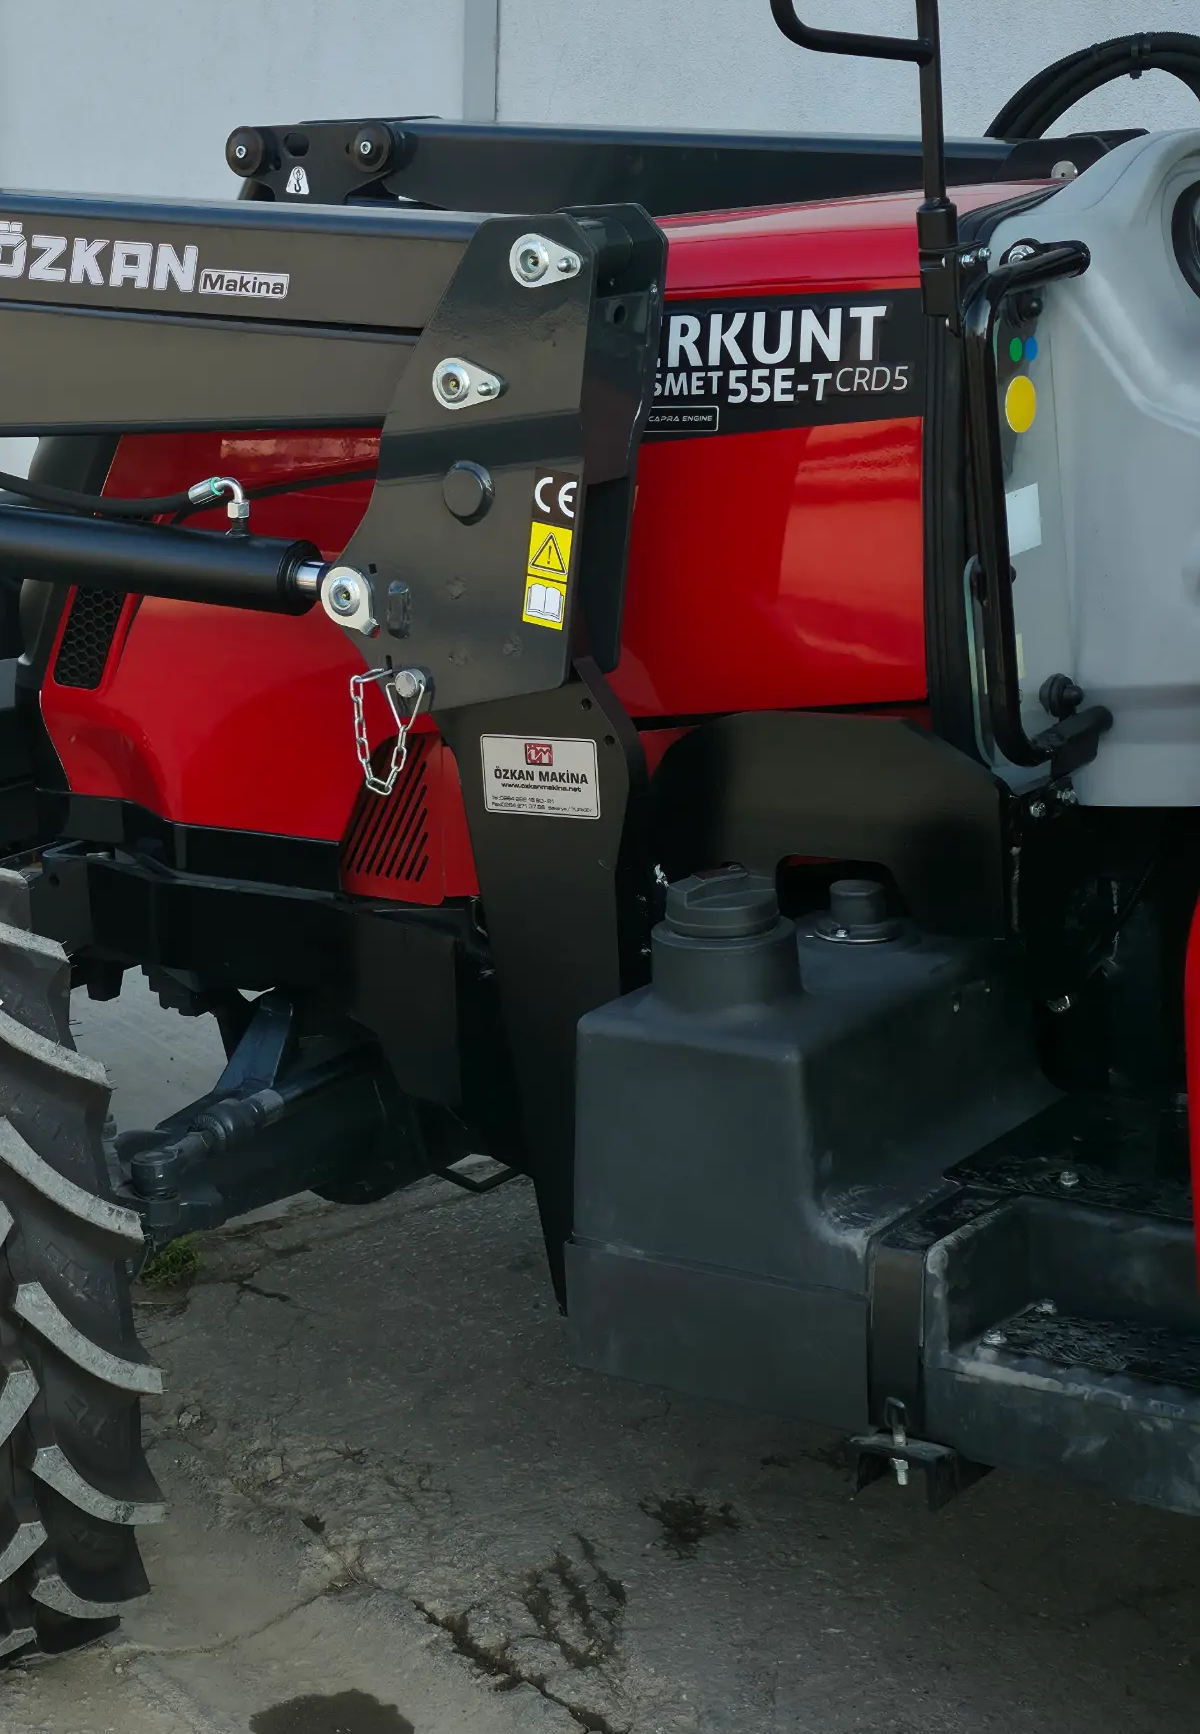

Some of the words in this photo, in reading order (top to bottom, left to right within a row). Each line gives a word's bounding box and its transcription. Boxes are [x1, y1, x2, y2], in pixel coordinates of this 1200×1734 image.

[203, 273, 285, 296] Makina
[657, 305, 887, 368] RKUNT
[535, 476, 577, 518] CE
[494, 766, 535, 781] ÖZKAN
[538, 769, 589, 785] MAKİNA
